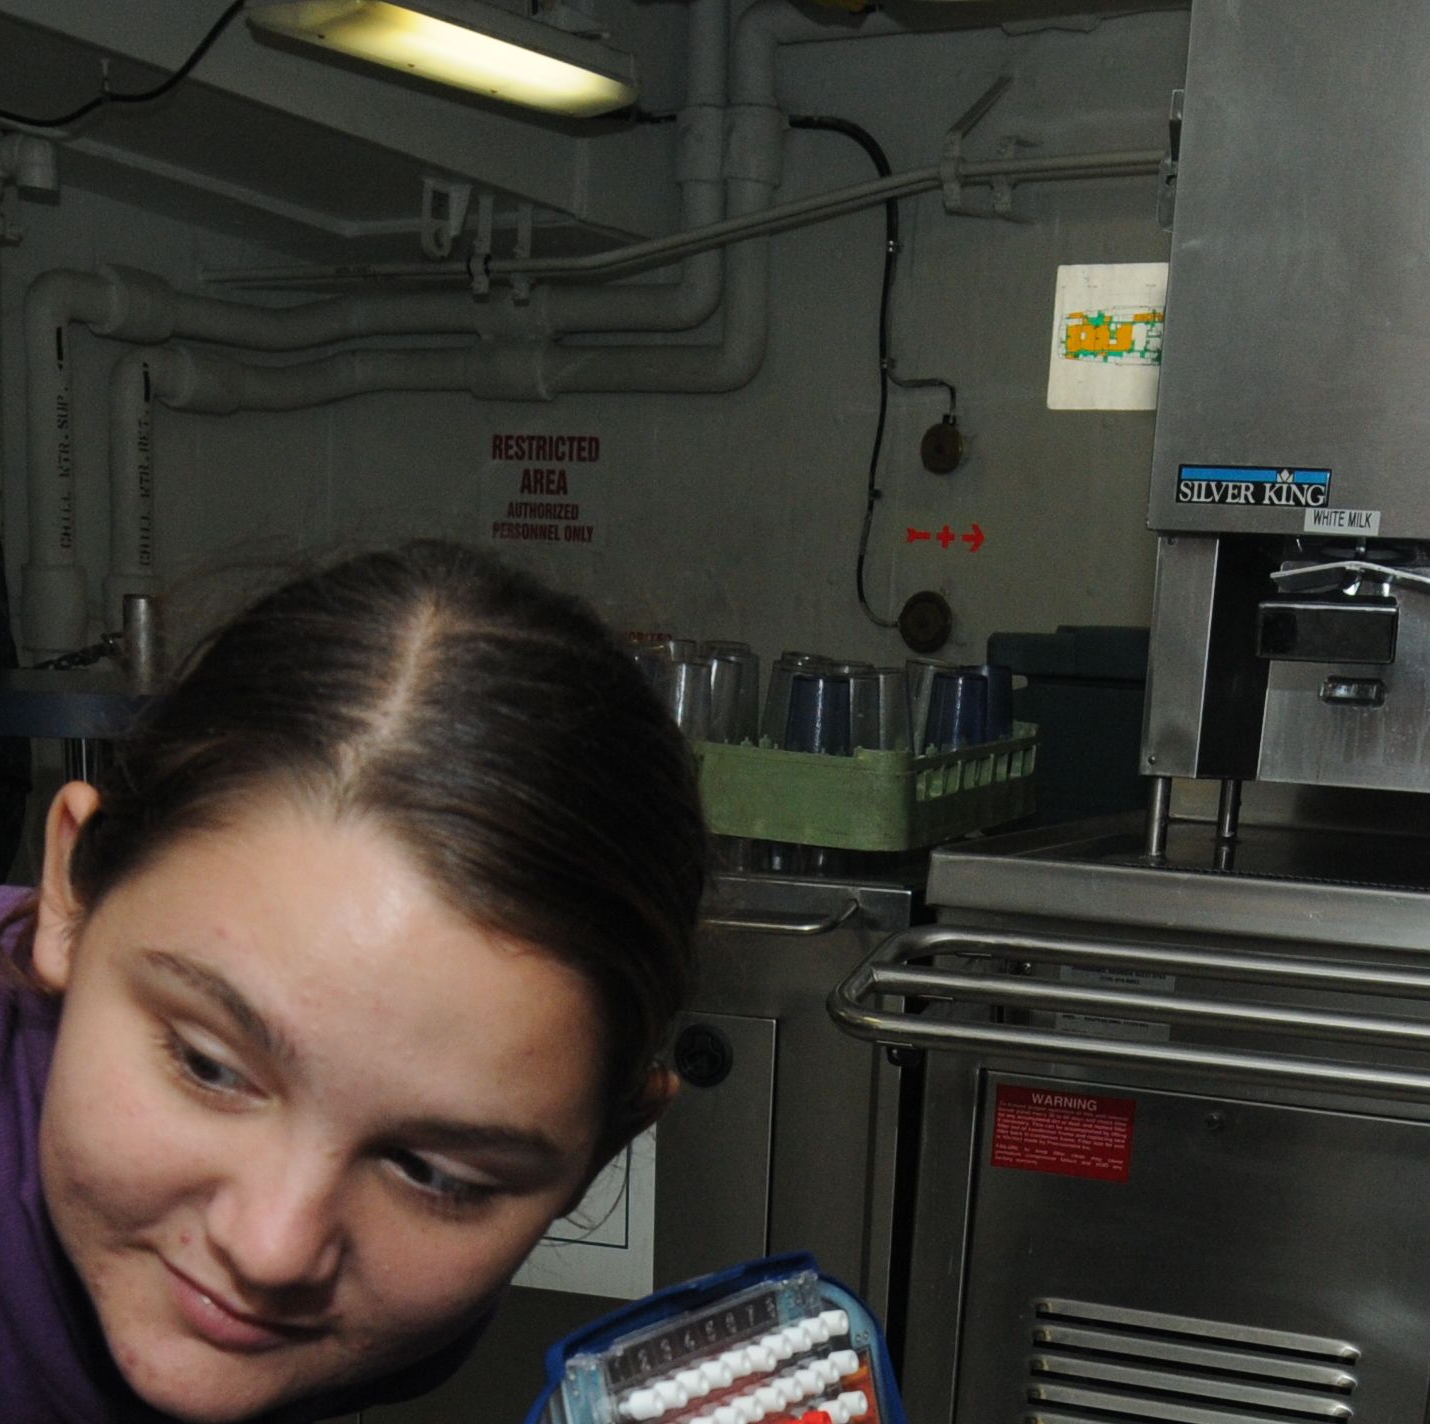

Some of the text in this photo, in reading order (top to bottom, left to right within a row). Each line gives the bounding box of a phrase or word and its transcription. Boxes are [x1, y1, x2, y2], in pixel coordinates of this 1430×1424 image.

[491, 433, 600, 463] RESTRICTED
[519, 467, 568, 496] AREA
[1178, 480, 1327, 507] SILVER KING
[506, 501, 580, 521] AUTHORIZED
[1313, 509, 1372, 529] WHITE MILK
[491, 521, 596, 543] PERSONNEL ONLY
[1031, 1092, 1098, 1112] WARNING
